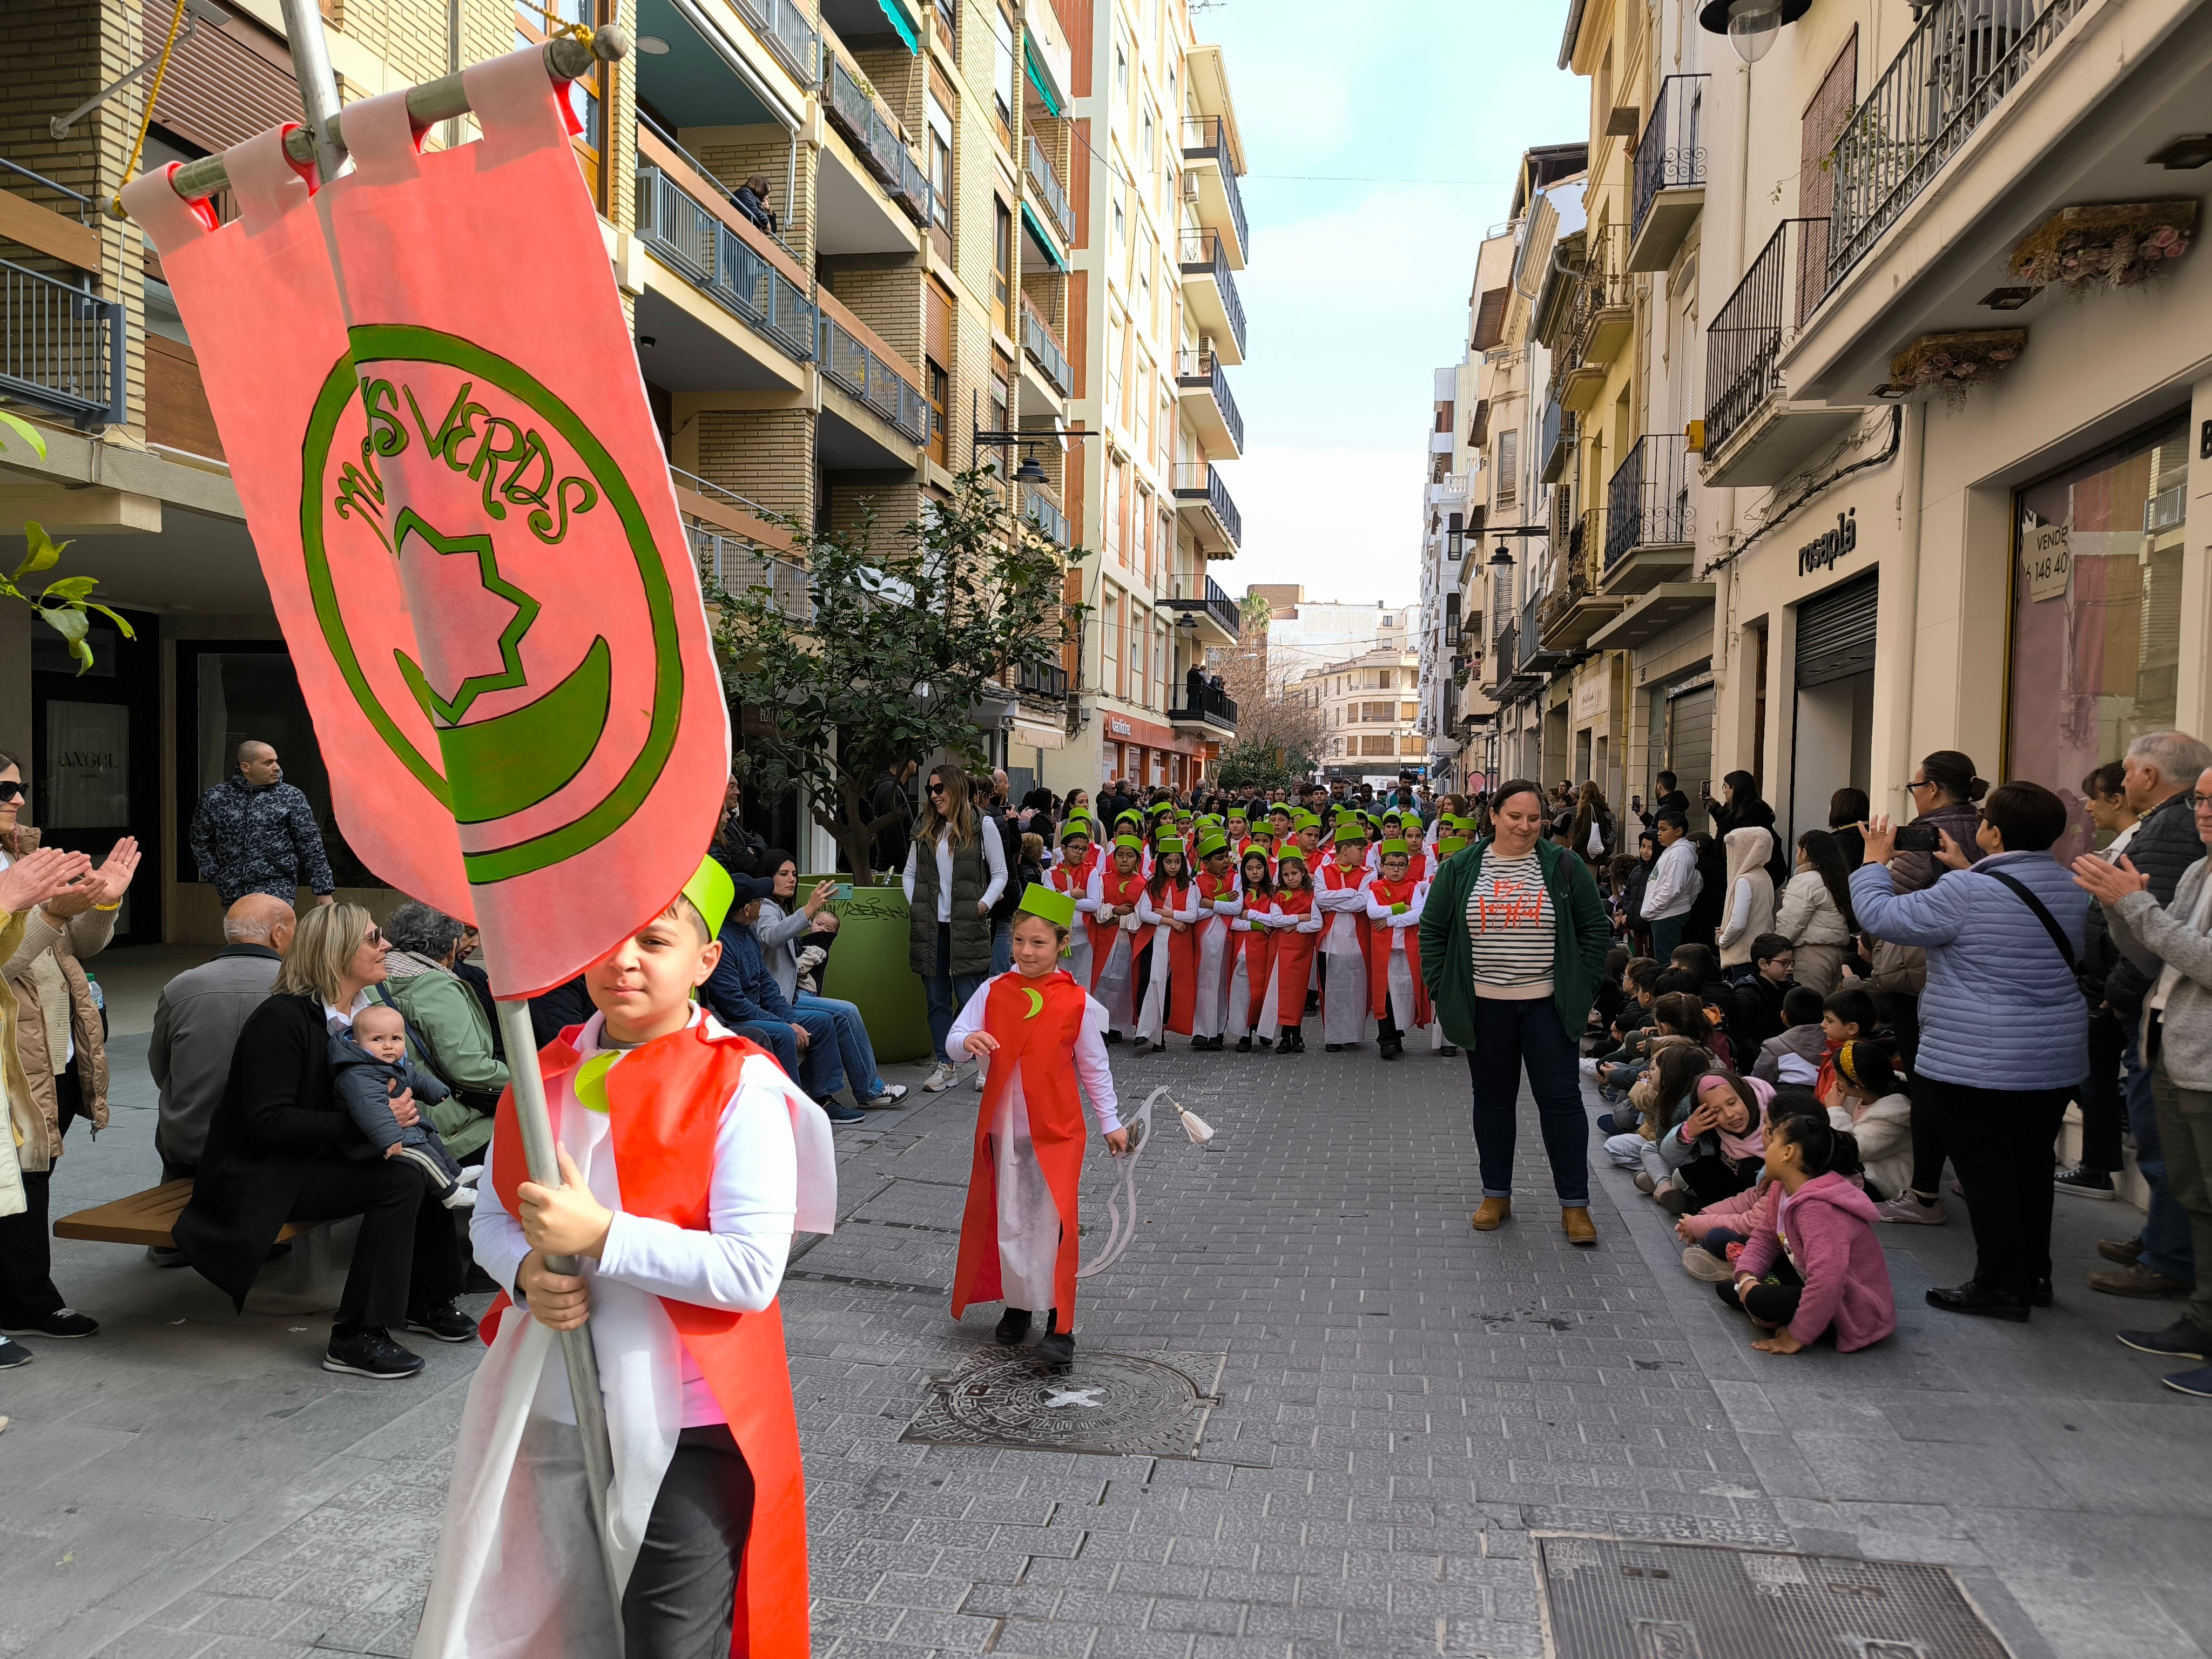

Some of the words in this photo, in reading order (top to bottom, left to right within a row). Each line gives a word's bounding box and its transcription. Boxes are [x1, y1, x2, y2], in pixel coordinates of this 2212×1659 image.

[402, 381, 598, 545] VERDS
[1799, 507, 1856, 577] rosaplá
[2035, 557, 2051, 582] 148
[2054, 551, 2068, 575] 40
[1468, 886, 1550, 936] Joyful
[1494, 879, 1525, 900] Be
